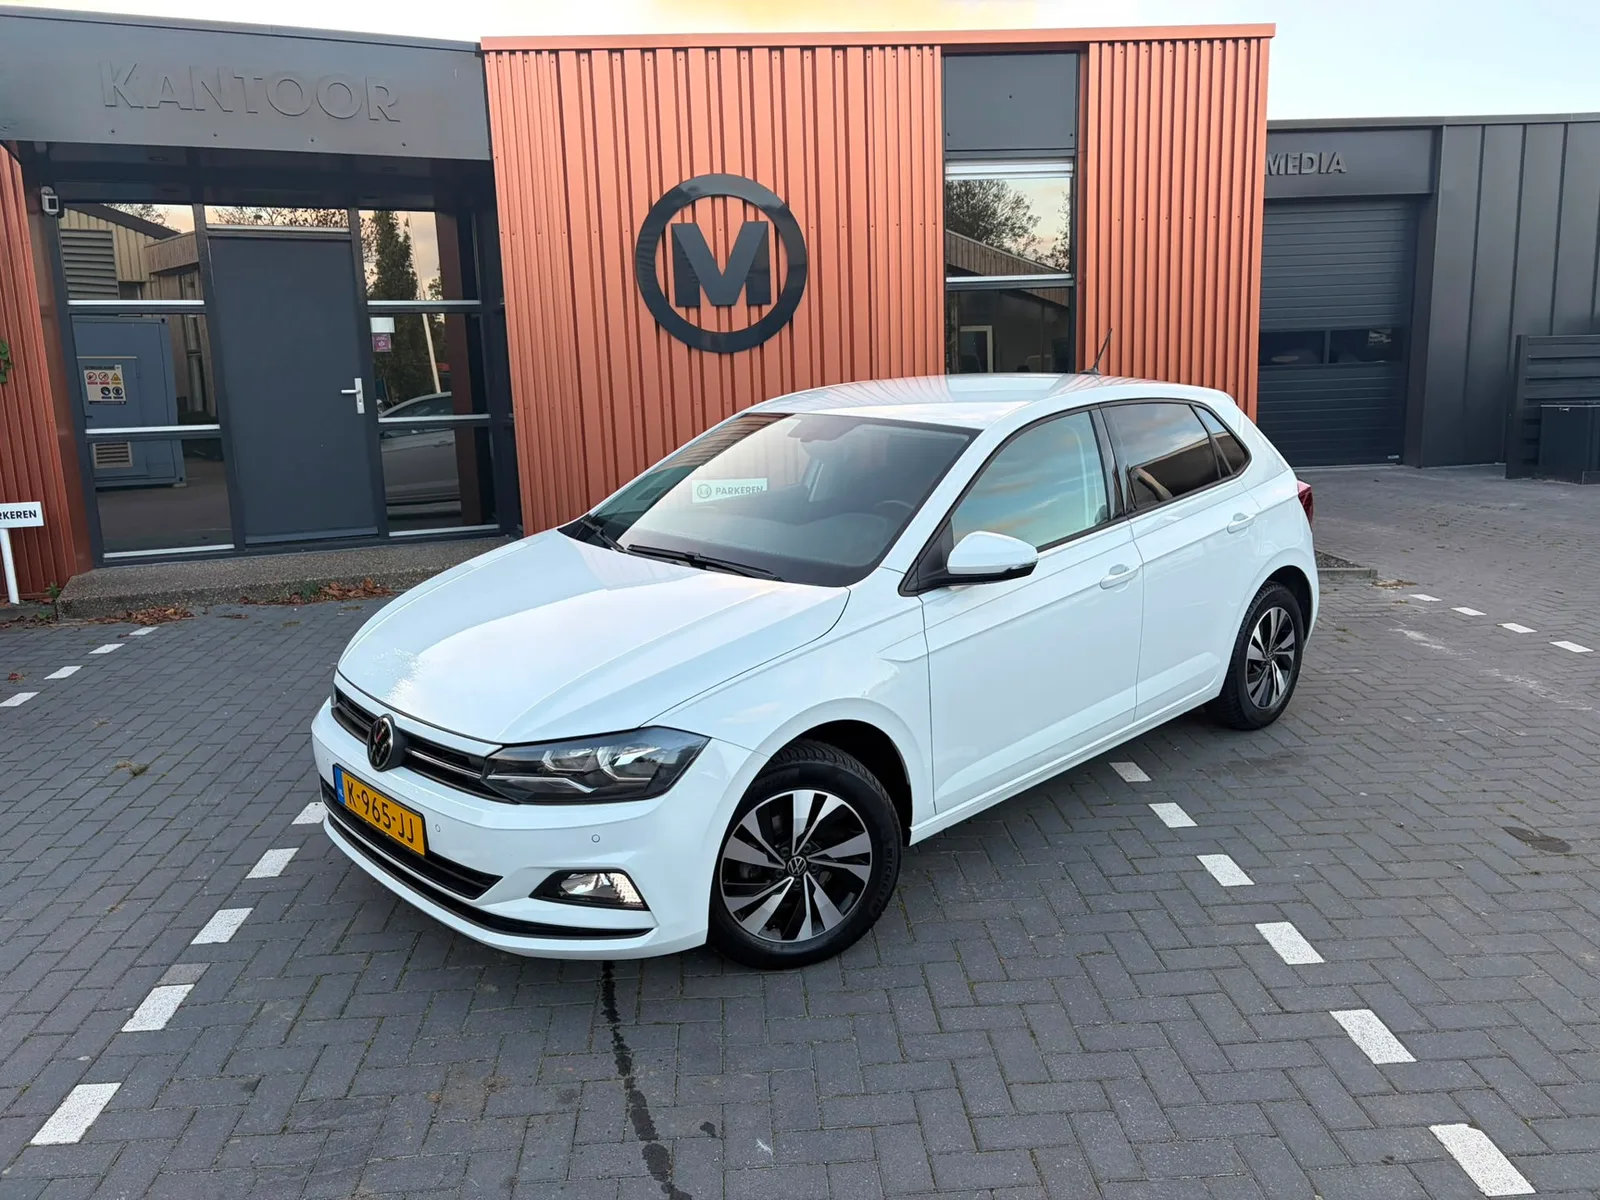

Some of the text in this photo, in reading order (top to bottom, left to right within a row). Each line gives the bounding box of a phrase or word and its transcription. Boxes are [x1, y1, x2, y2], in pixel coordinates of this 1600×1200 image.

[99, 61, 401, 123] KANTOOR
[1265, 152, 1347, 176] MEDIA
[671, 221, 772, 307] M
[715, 486, 764, 496] PARKEREN
[346, 779, 414, 844] K-965-JJ
